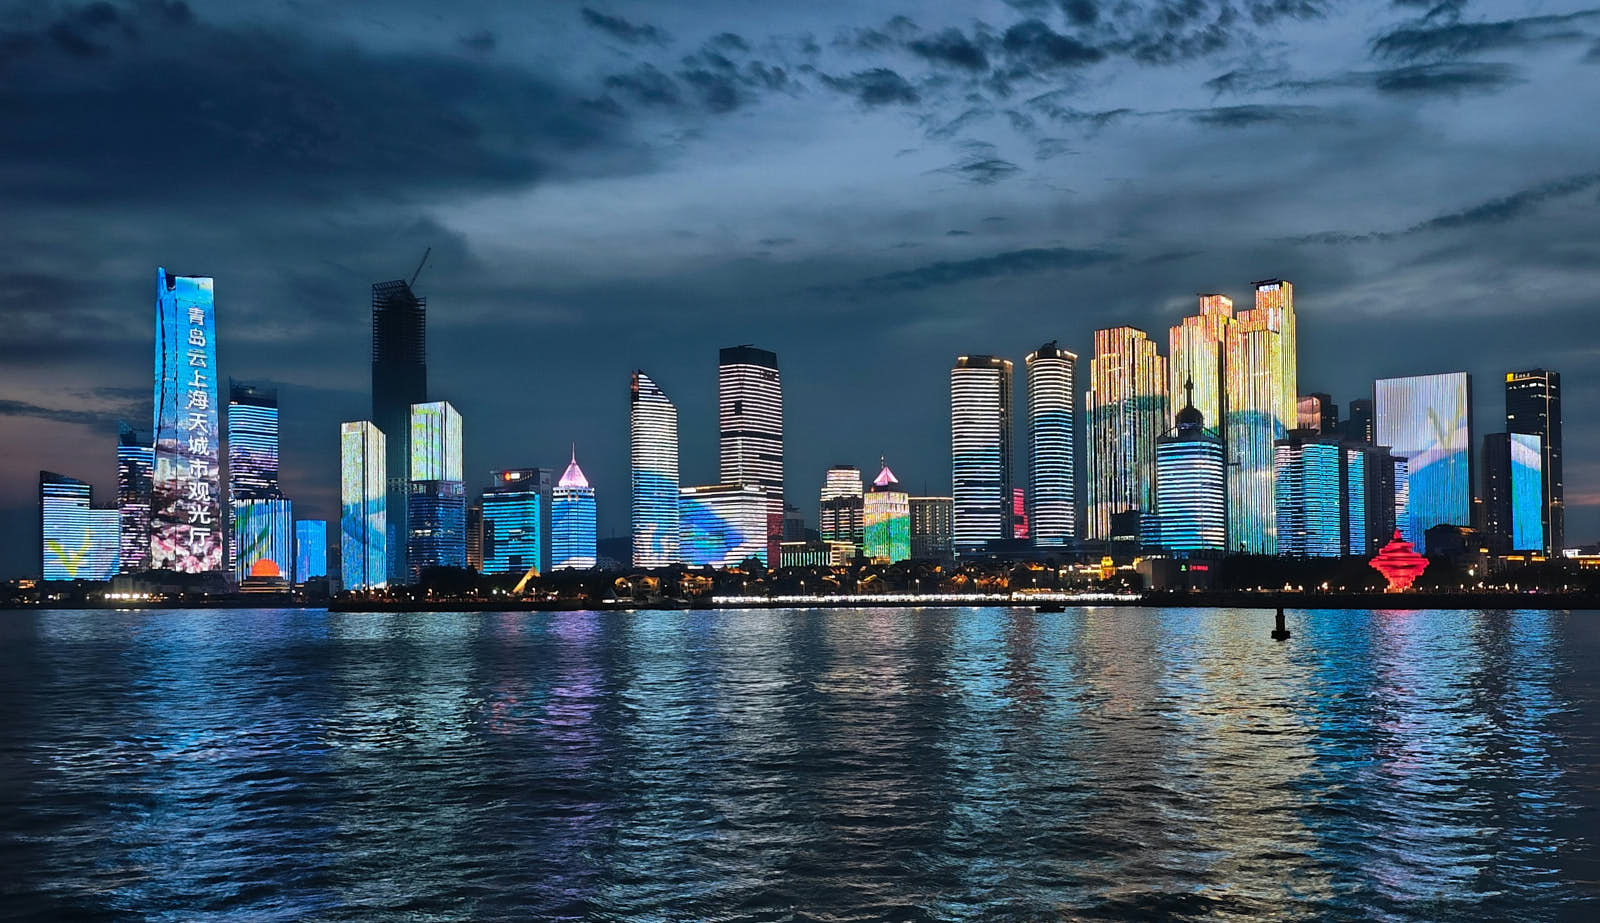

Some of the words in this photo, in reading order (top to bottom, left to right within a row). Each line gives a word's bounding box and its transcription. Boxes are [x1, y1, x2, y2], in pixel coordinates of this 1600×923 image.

[187, 306, 211, 547] 青岛云上海天城市观光厅
